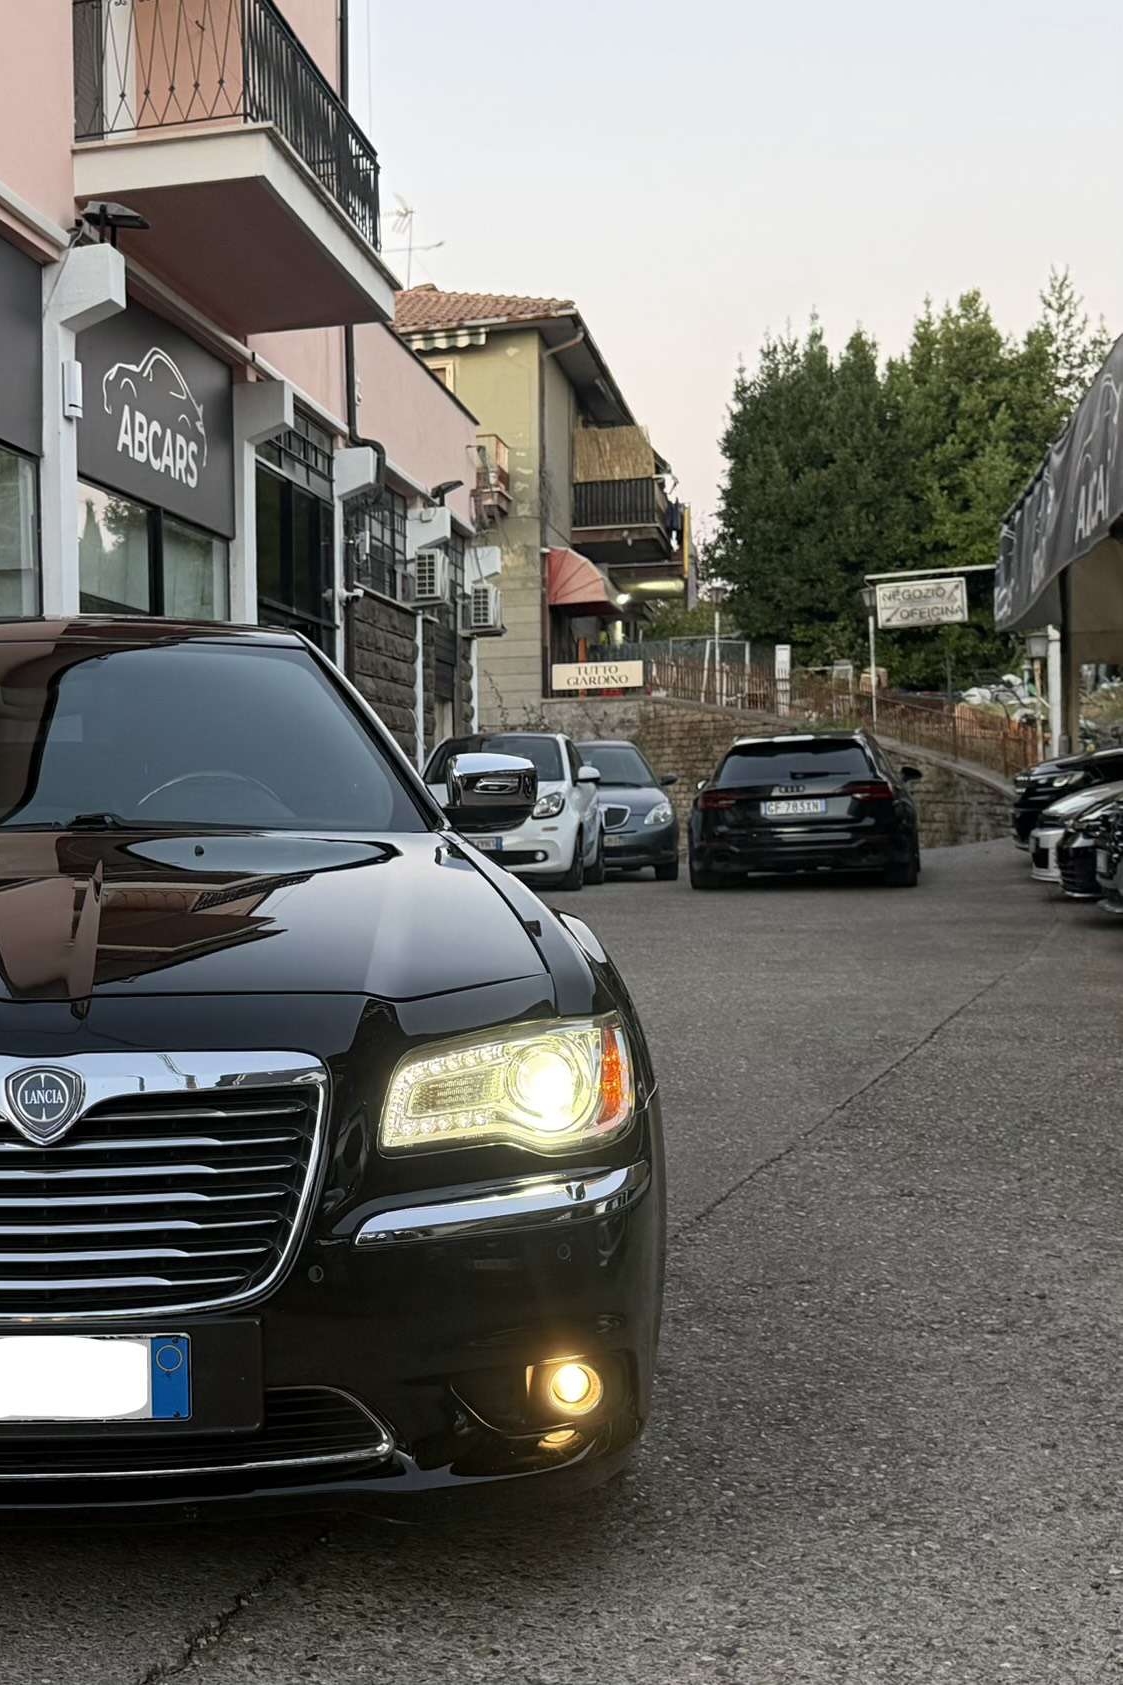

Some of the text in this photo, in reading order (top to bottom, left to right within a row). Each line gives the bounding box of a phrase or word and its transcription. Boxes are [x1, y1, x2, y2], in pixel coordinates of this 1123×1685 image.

[116, 404, 198, 488] ABCARS
[882, 586, 946, 601] NEGOZIO
[575, 665, 618, 676] TUTTO
[566, 674, 628, 686] GIARDINO
[24, 1089, 64, 1104] LANCIA
